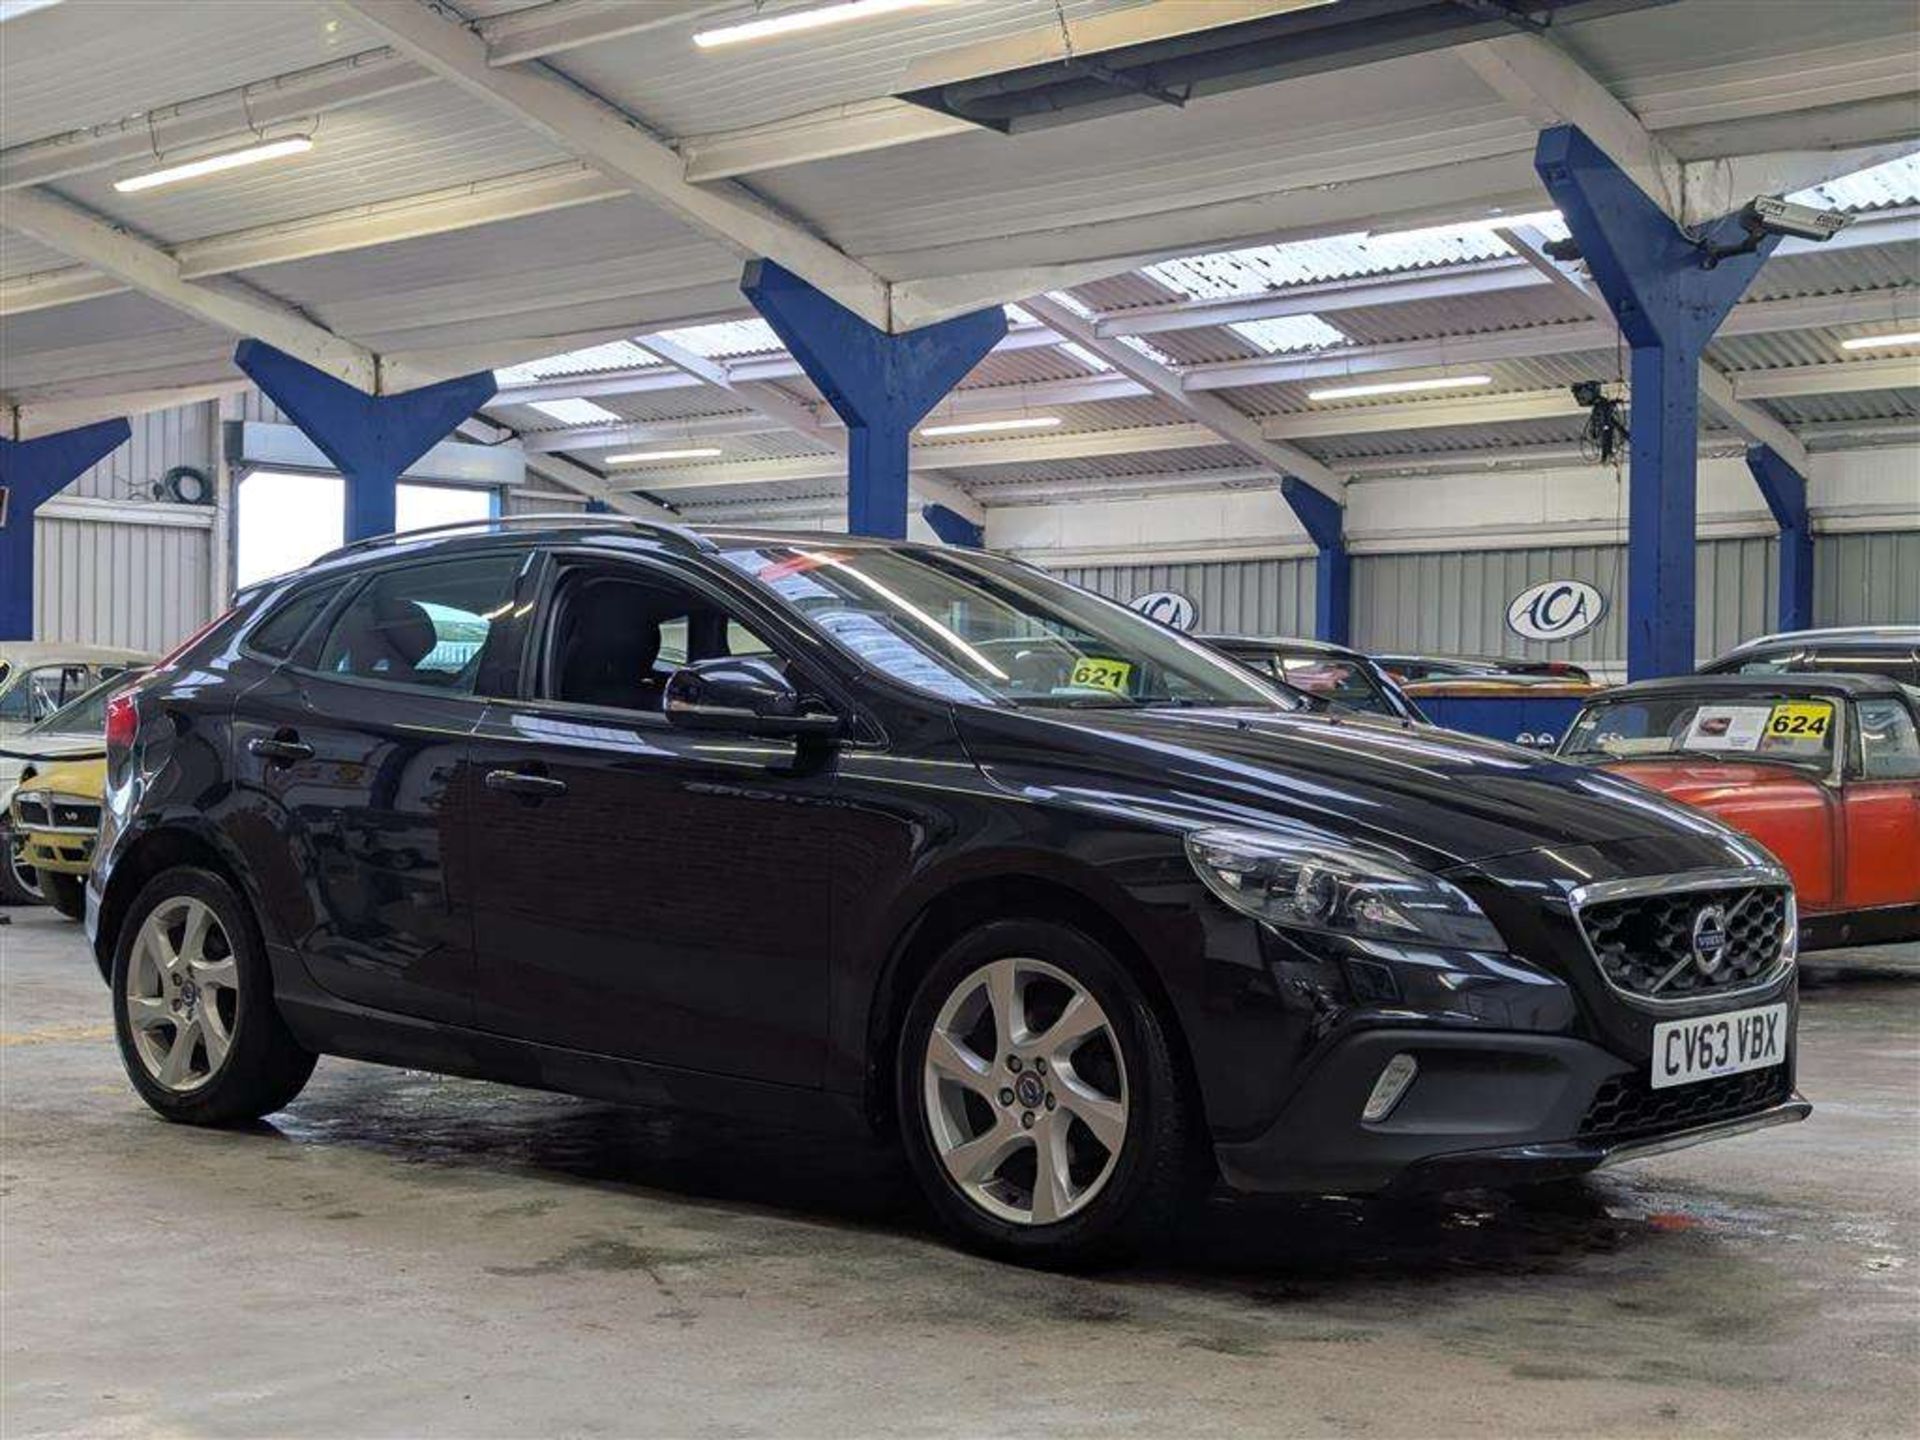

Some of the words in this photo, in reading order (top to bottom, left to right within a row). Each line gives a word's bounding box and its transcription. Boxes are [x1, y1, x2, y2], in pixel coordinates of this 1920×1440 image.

[1515, 586, 1588, 631] ACA
[1074, 667, 1123, 688] 621
[1773, 715, 1825, 735] 624
[1665, 1021, 1729, 1076] CV63
[1738, 1012, 1778, 1062] VBX
